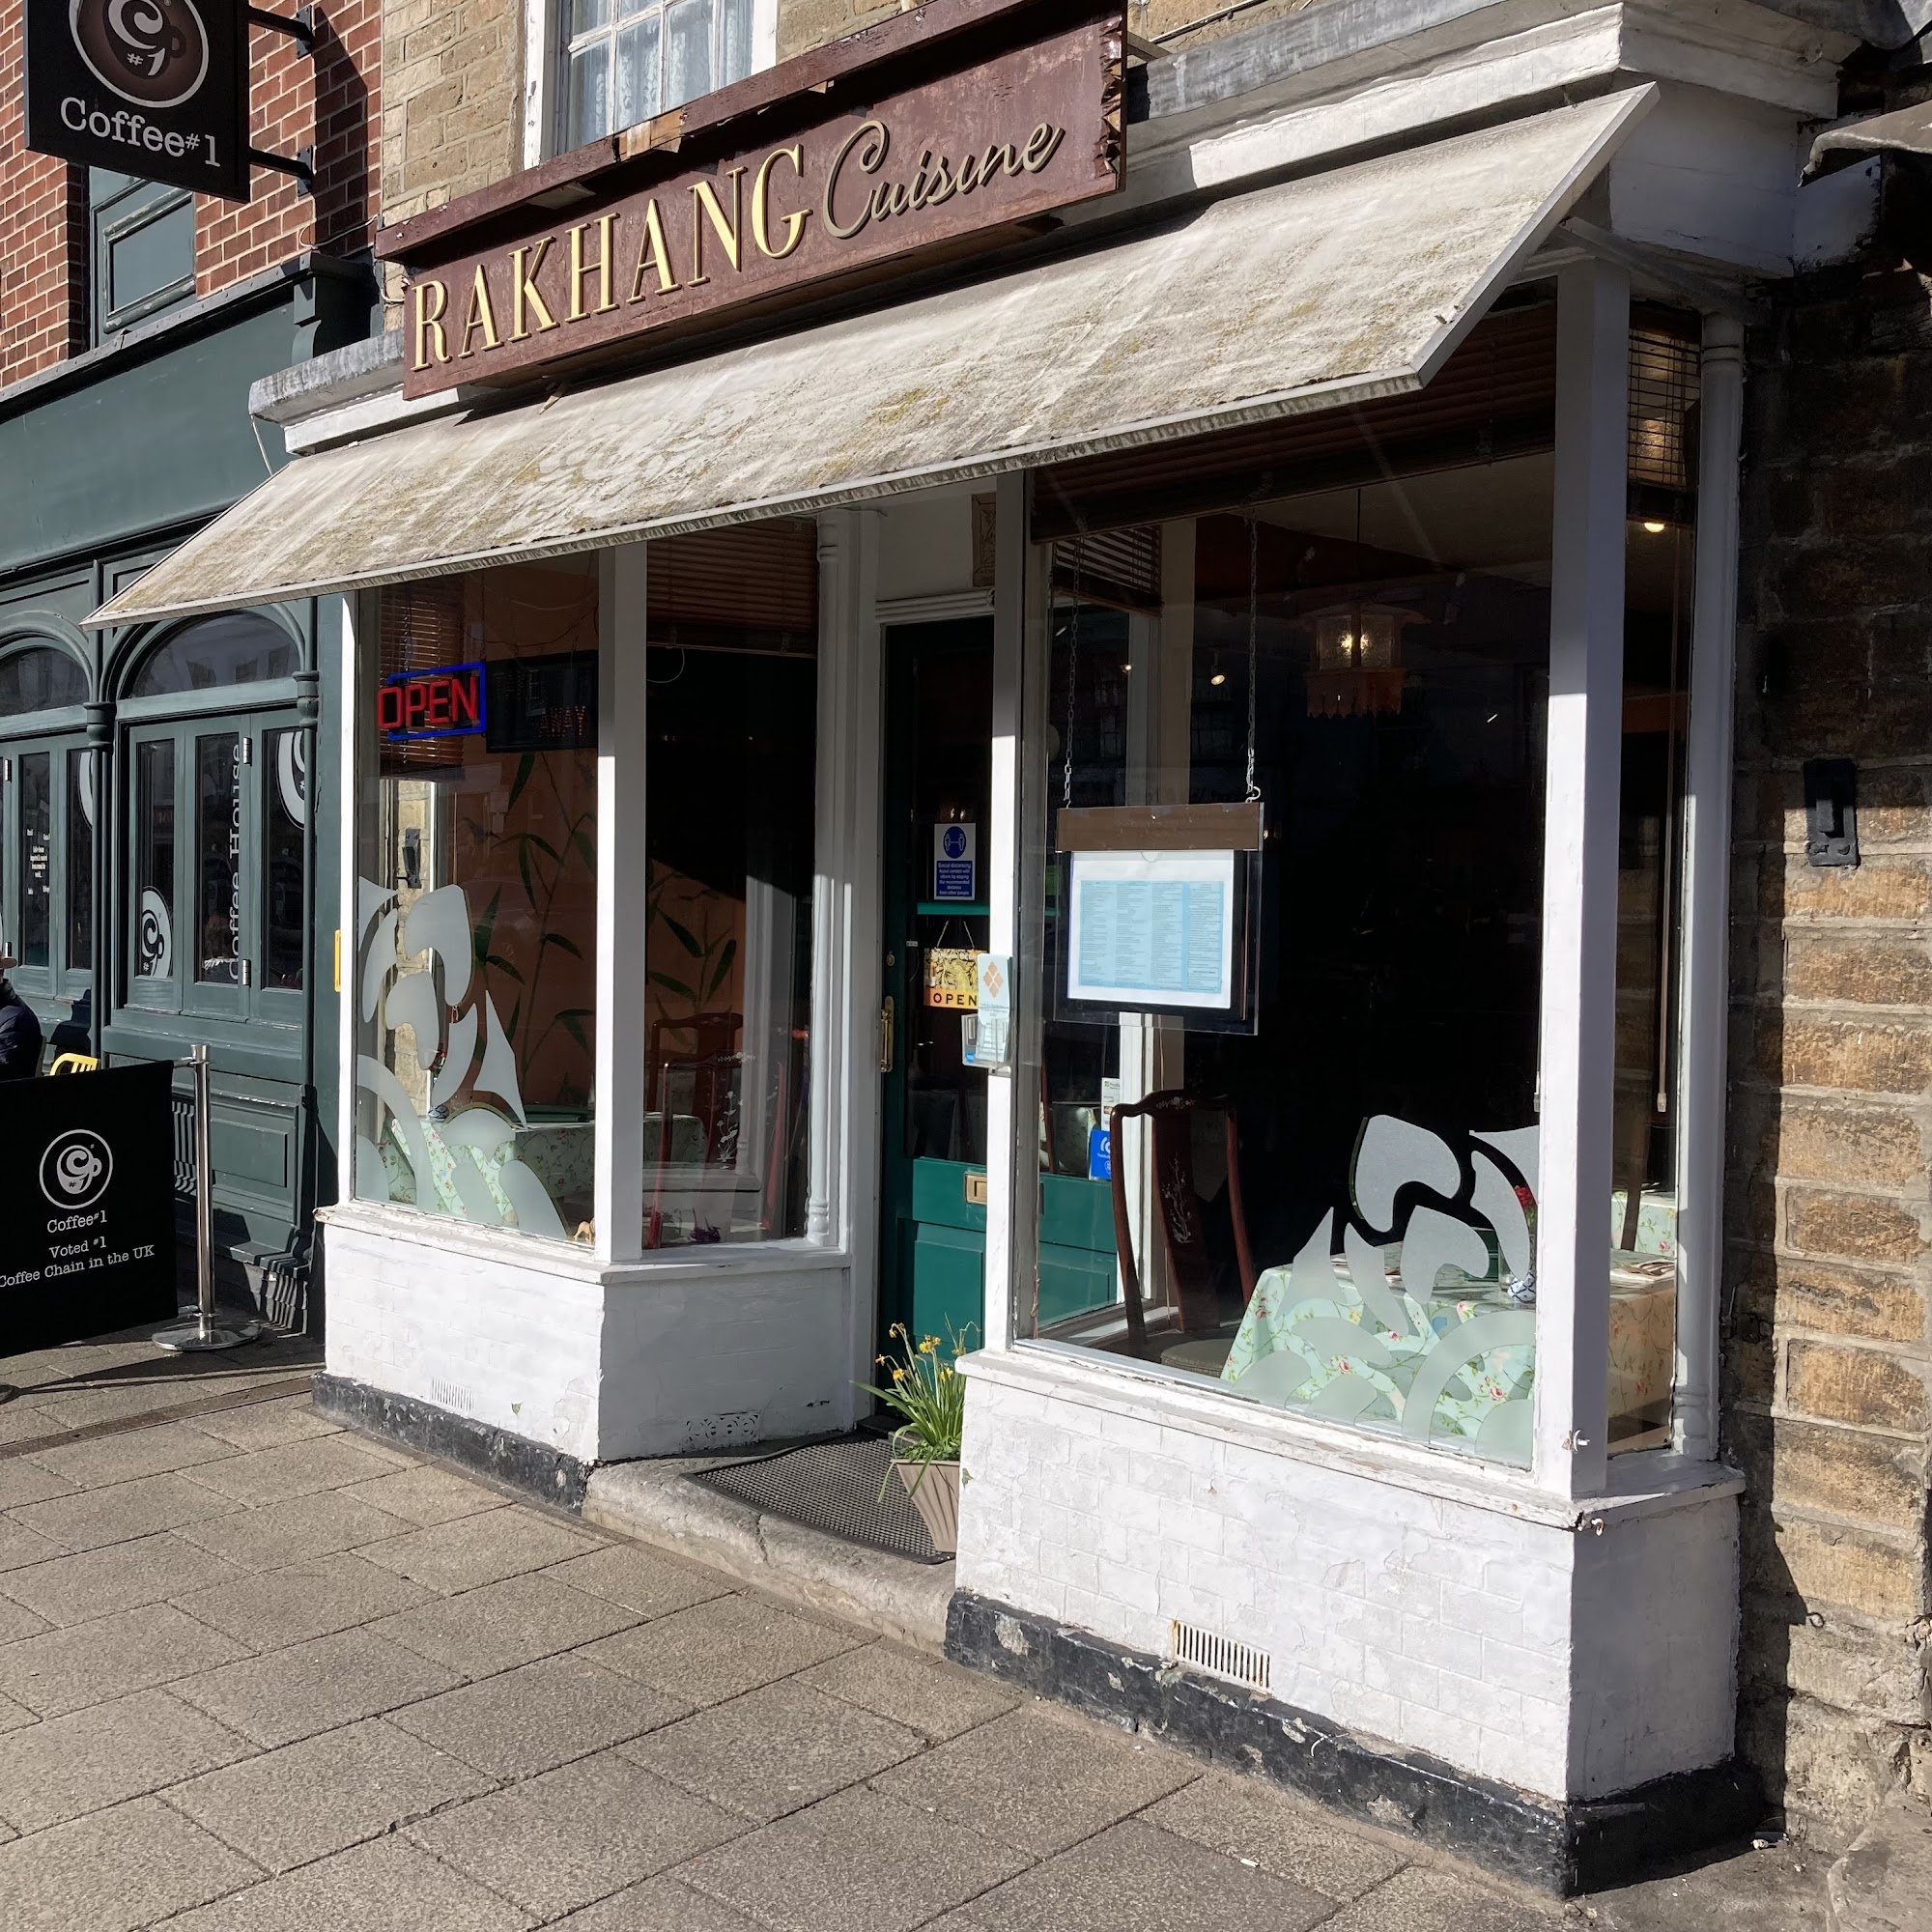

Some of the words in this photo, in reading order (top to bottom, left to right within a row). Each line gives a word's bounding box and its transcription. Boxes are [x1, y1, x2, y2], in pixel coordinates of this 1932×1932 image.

[60, 97, 221, 167] Coffee#1
[412, 144, 812, 373] RAKHANG
[822, 120, 1065, 239] Cuisine
[377, 676, 478, 729] OPEN
[933, 993, 978, 1007] OPEN
[46, 1210, 107, 1234] Coffee#1
[0, 1270, 41, 1288] Coffee
[44, 1261, 85, 1278] Chain
[89, 1257, 104, 1268] in
[107, 1252, 129, 1264] the
[132, 1244, 155, 1259] UK
[48, 1240, 89, 1259] Voted
[93, 1236, 107, 1249] #1
